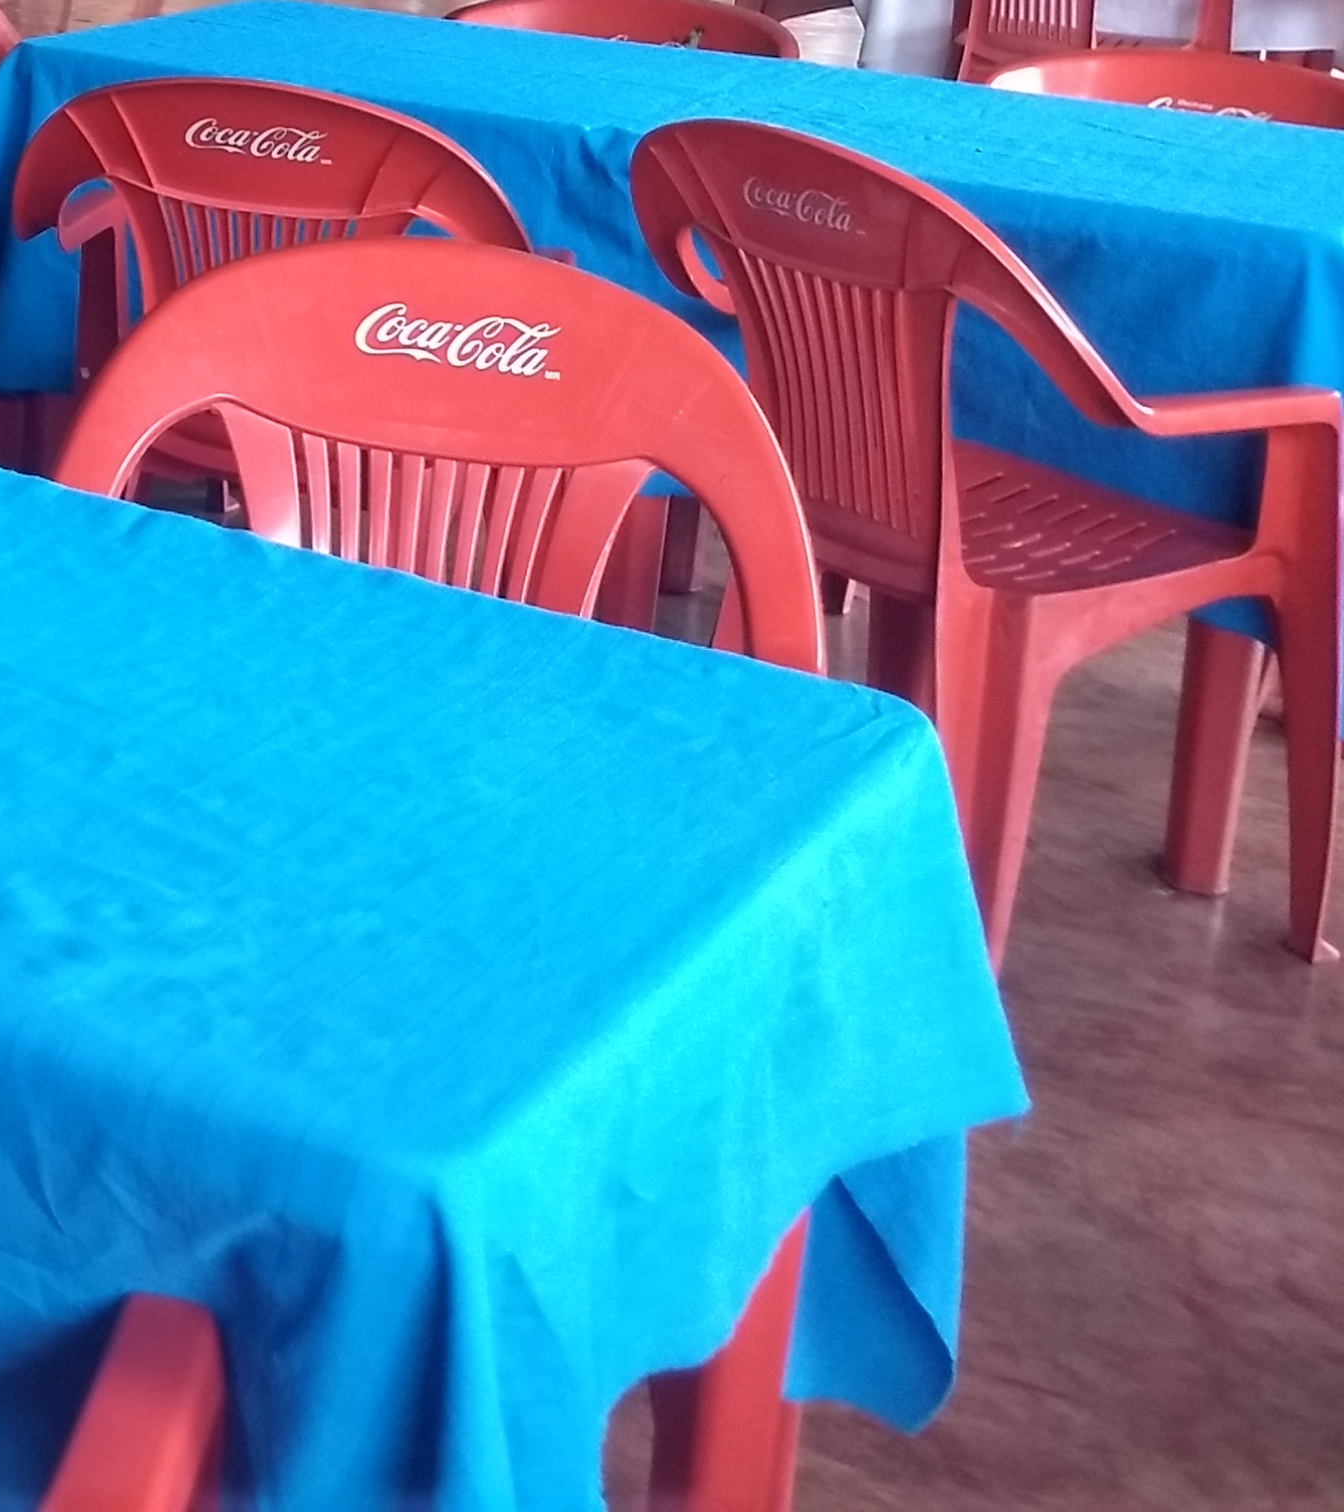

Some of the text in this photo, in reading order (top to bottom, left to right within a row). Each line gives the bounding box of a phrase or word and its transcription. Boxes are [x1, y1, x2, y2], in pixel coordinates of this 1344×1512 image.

[185, 117, 328, 163] Coca-Cola
[743, 176, 850, 232] Coca-Cola
[355, 302, 562, 376] Coca-Cola
